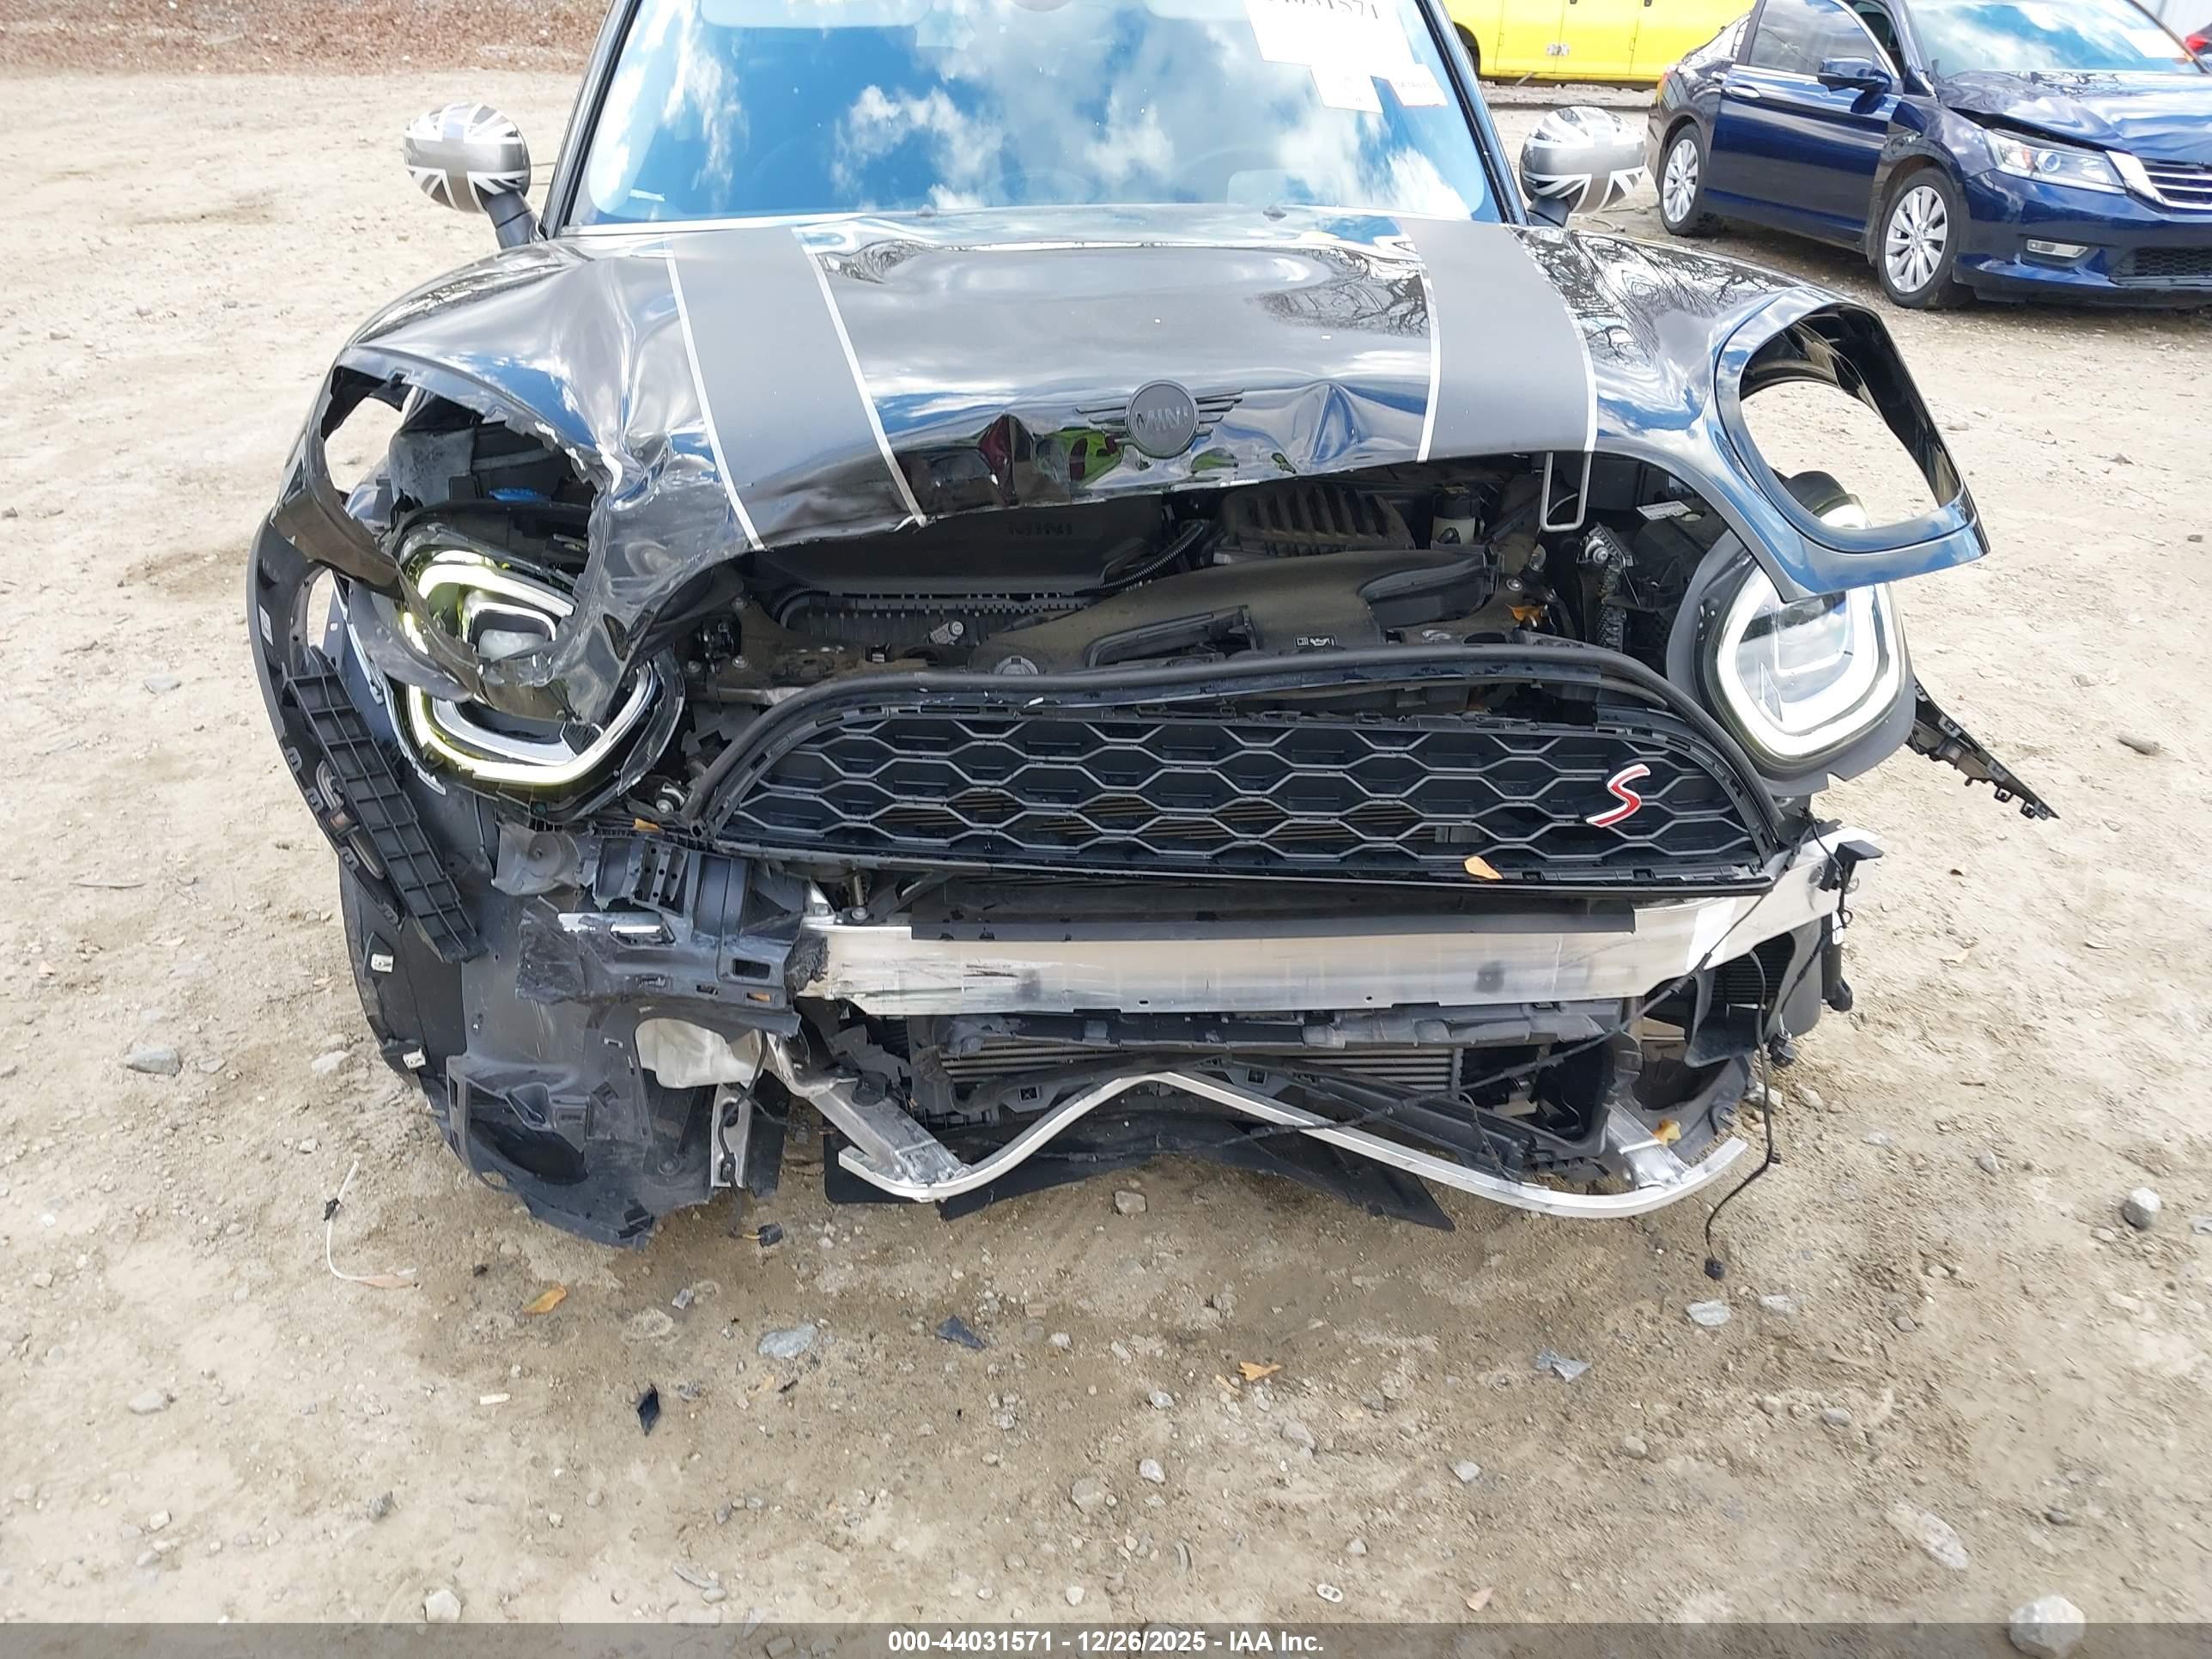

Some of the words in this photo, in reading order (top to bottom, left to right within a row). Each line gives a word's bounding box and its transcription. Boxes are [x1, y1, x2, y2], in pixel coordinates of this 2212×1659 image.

[1133, 405, 1188, 431] MINI
[1010, 521, 1073, 536] MINI
[1585, 763, 1651, 829] S
